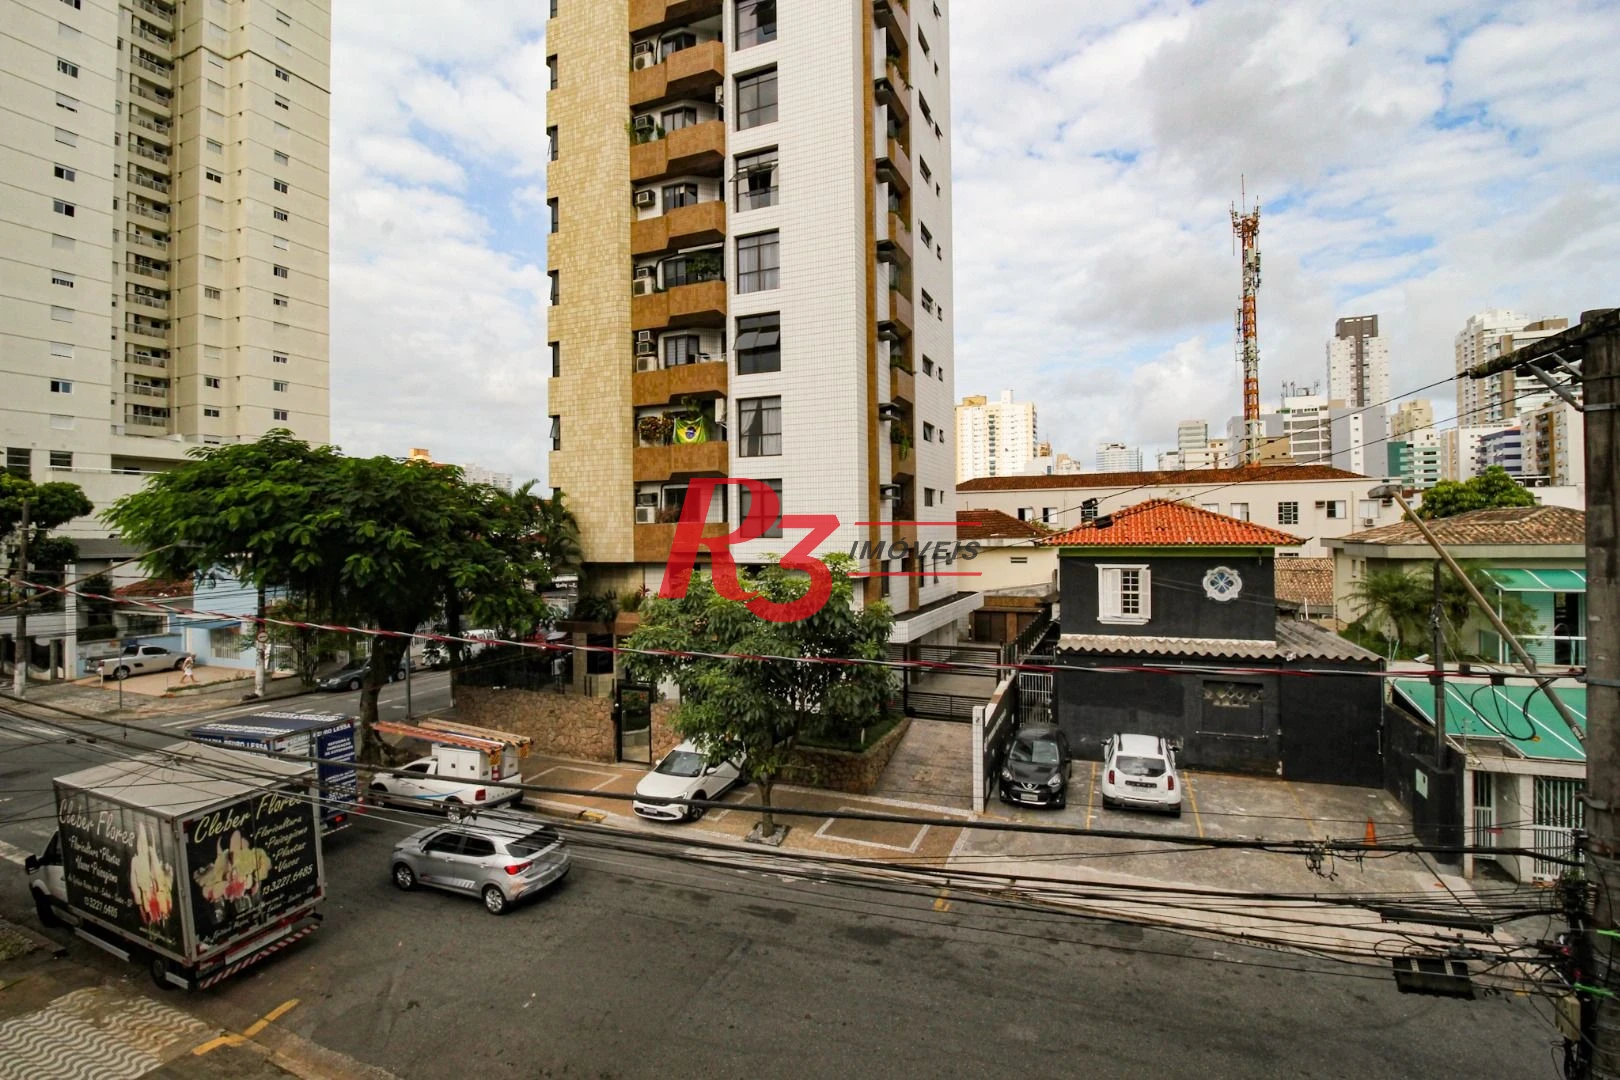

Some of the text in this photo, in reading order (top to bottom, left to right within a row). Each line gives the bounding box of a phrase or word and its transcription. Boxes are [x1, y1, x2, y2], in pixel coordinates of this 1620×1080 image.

[58, 799, 136, 847] Cleber Flores
[194, 809, 251, 843] Cleber
[256, 791, 305, 820] Flores
[274, 842, 307, 861] Plantas
[278, 857, 300, 873] Vasos
